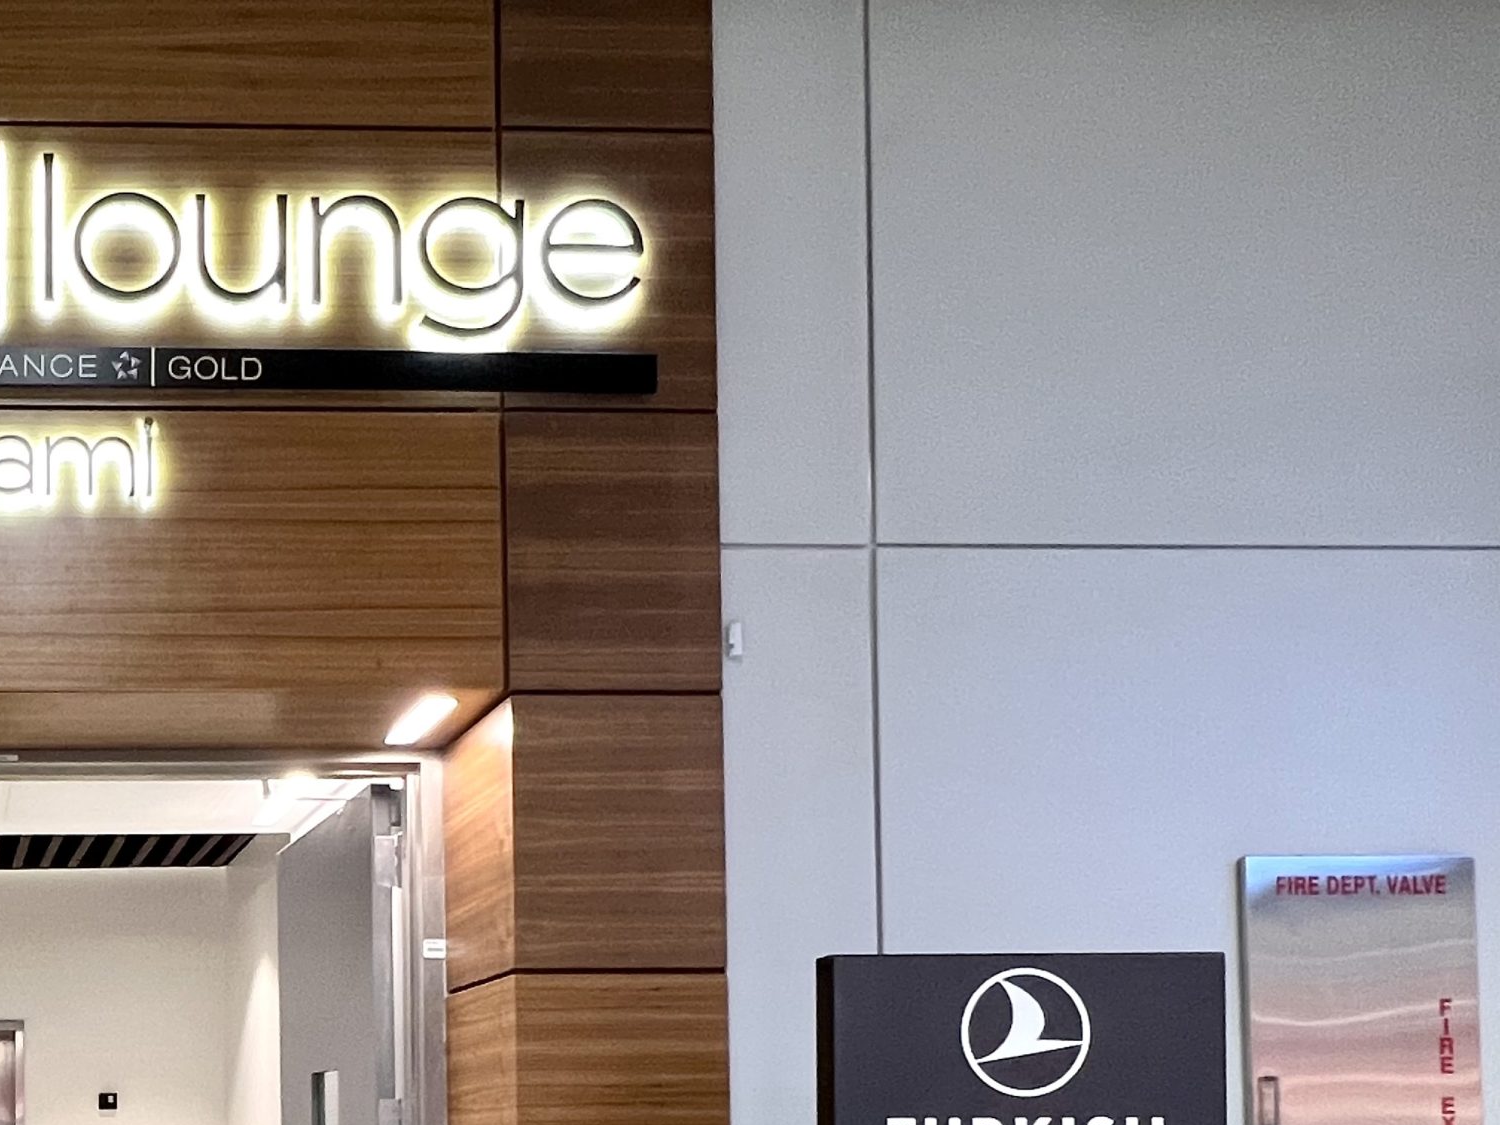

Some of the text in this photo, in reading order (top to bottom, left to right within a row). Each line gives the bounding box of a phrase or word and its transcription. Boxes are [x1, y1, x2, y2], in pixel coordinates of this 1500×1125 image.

[43, 152, 645, 337] lounge
[167, 356, 263, 381] GOLD
[1276, 874, 1446, 895] FIRE DEPT. VALVE
[1439, 998, 1454, 1075] FIRE
